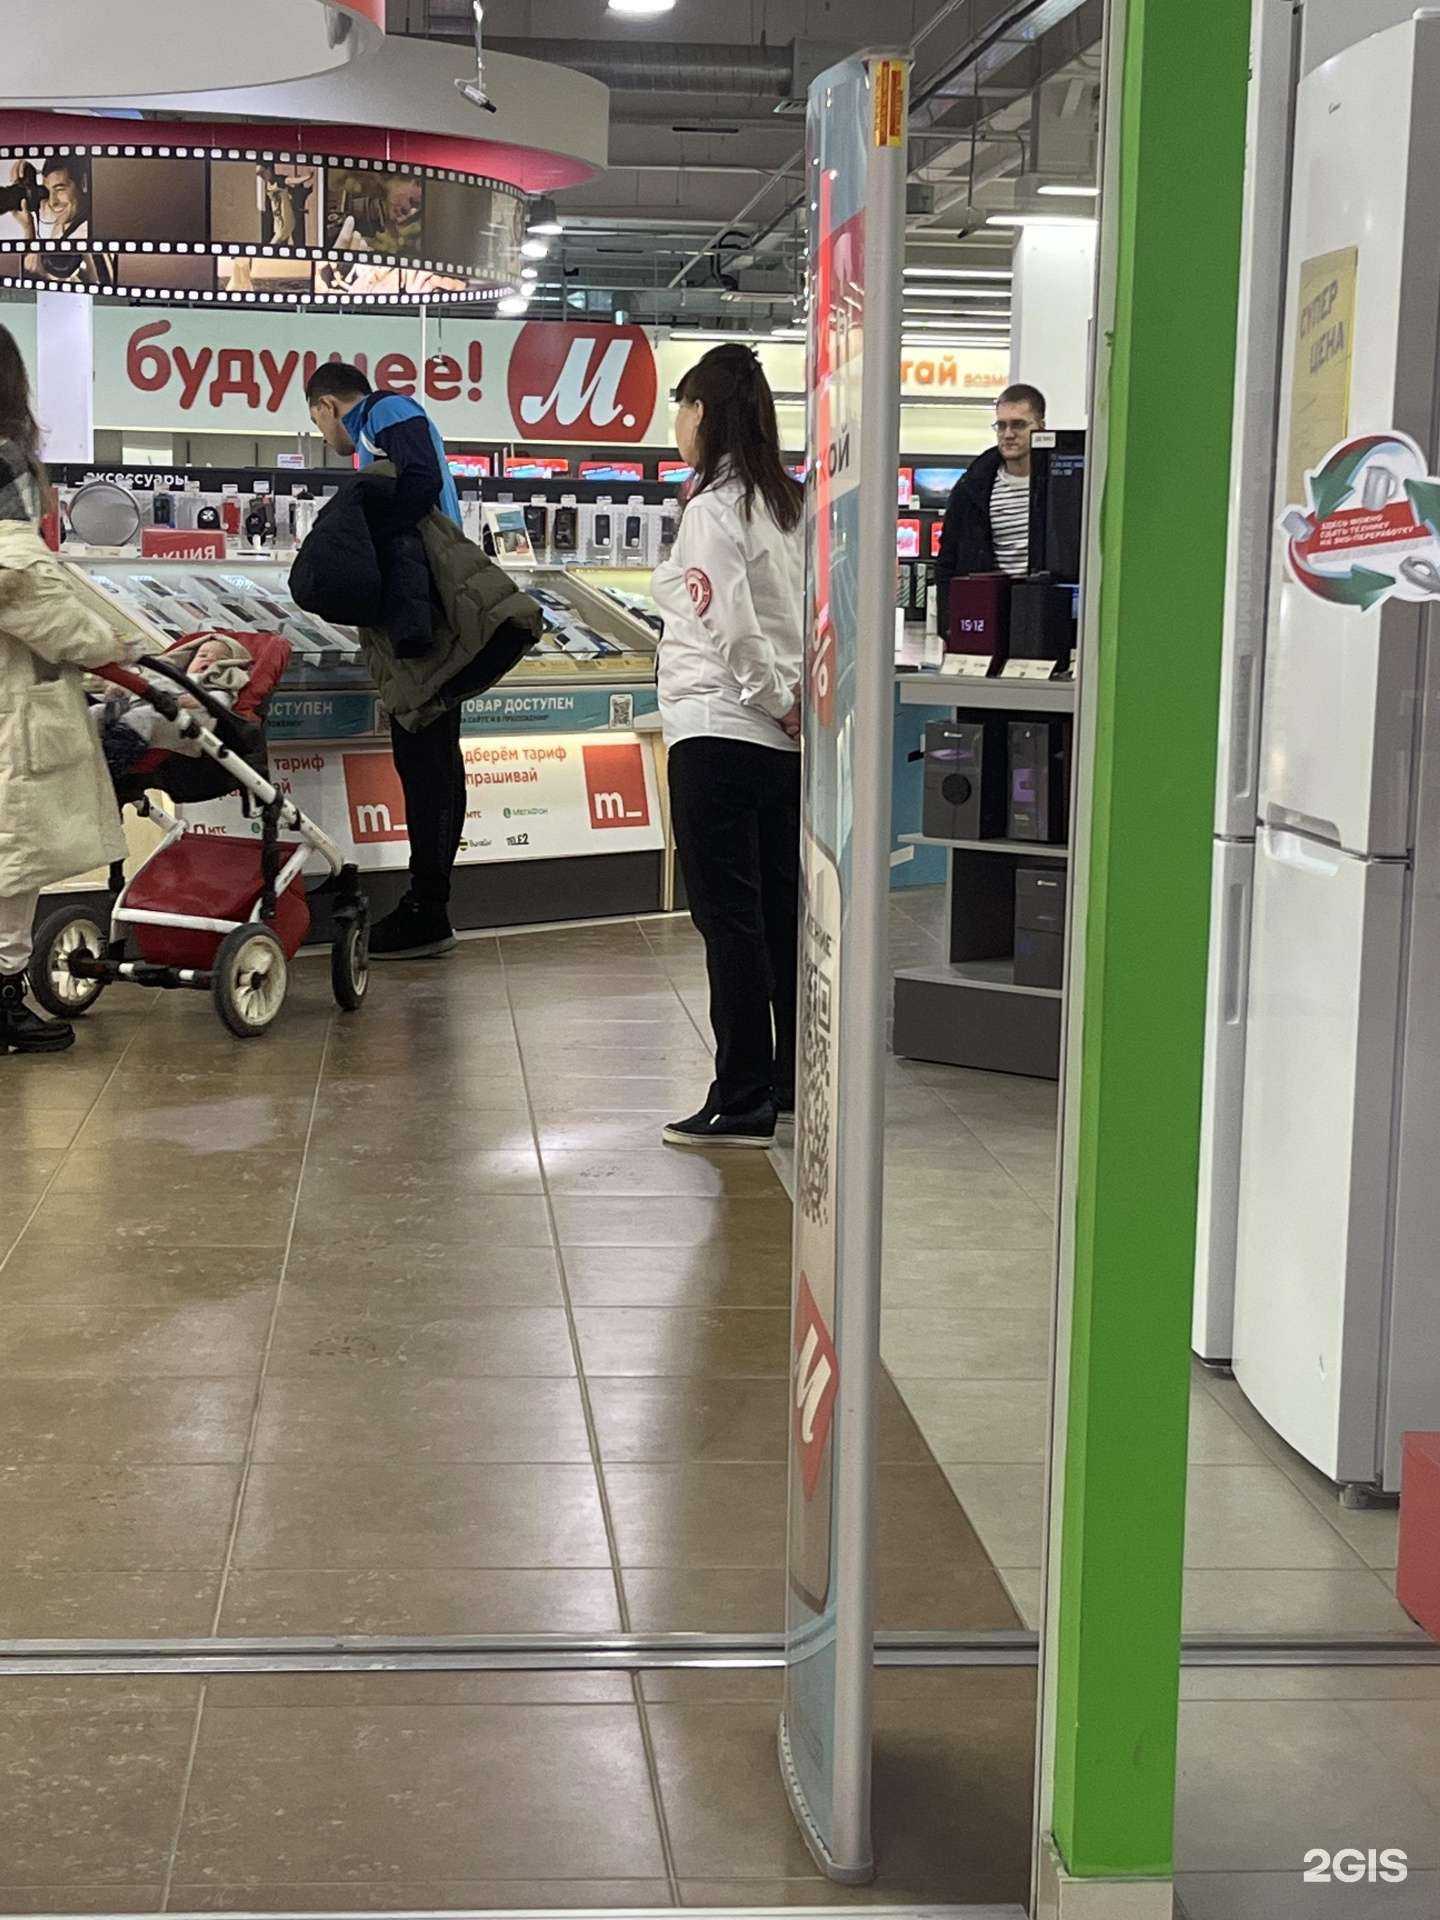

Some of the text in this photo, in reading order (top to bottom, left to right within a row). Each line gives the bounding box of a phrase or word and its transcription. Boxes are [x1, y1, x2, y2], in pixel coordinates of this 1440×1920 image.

[127, 319, 482, 413] будуее!
[504, 697, 575, 714] ДОСТУПЕН
[274, 754, 325, 772] тариф
[523, 745, 567, 763] тариф
